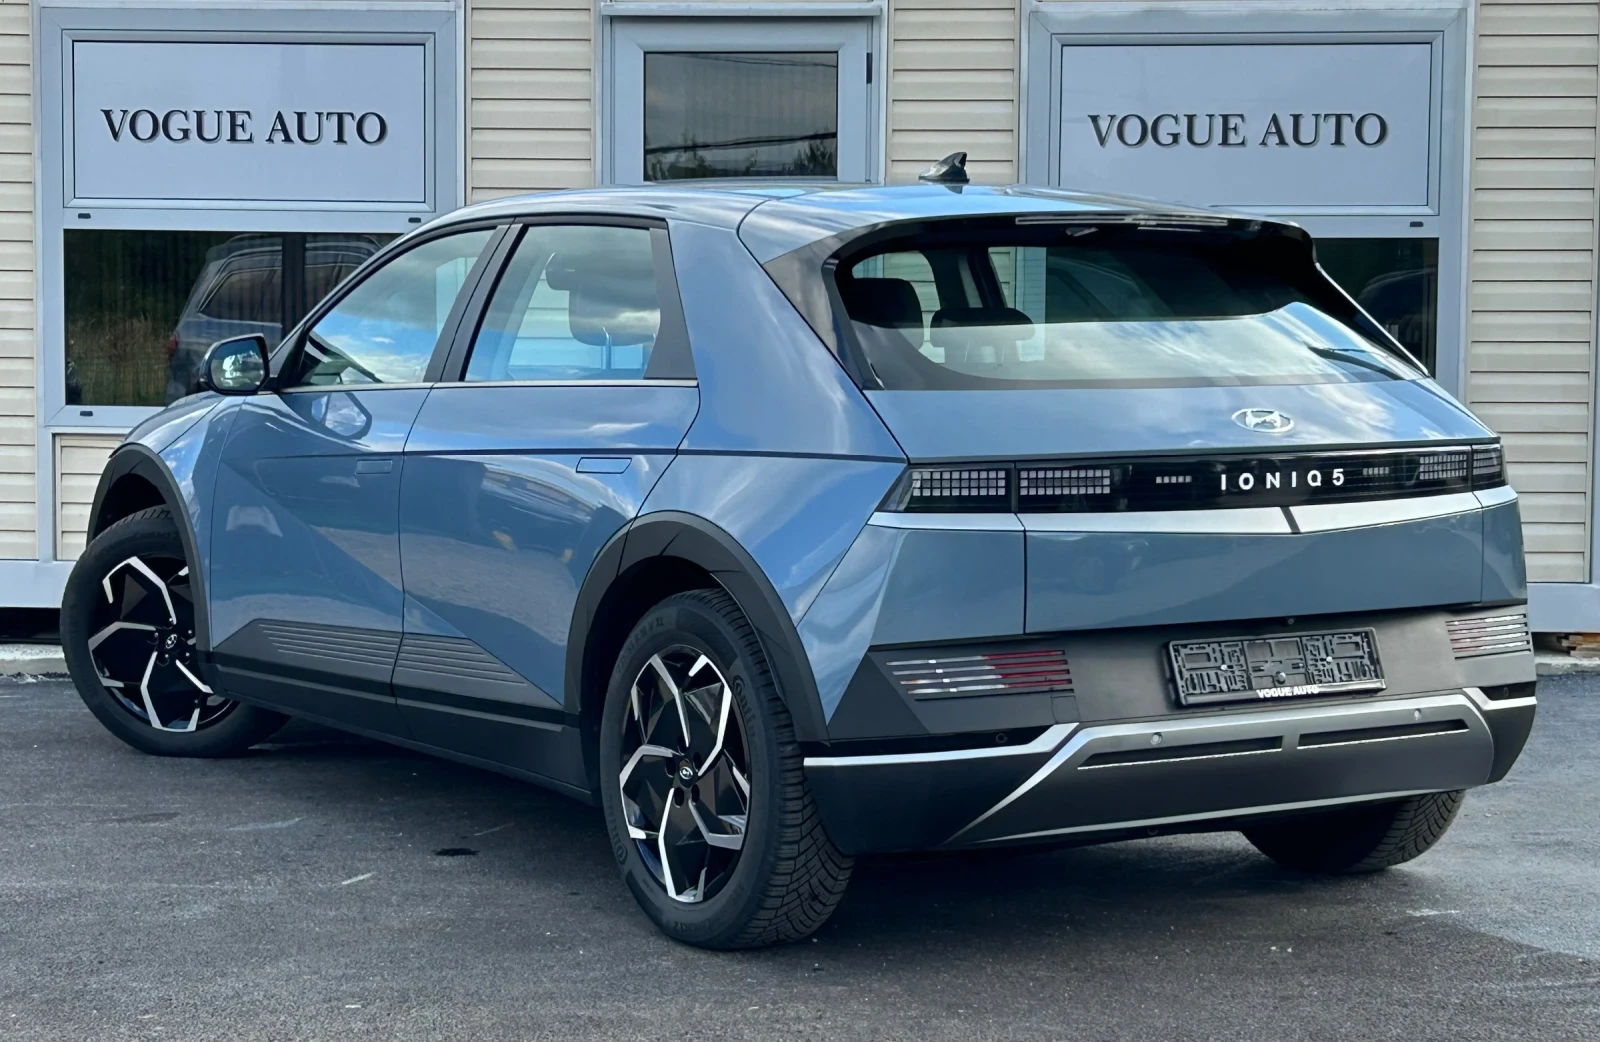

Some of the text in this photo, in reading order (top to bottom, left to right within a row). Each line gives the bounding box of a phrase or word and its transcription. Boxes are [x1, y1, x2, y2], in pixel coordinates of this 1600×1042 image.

[101, 109, 388, 145] VOGUE AUTO
[1088, 113, 1389, 148] VOGUE AUTO
[1256, 684, 1320, 699] VOGUE AUTO
